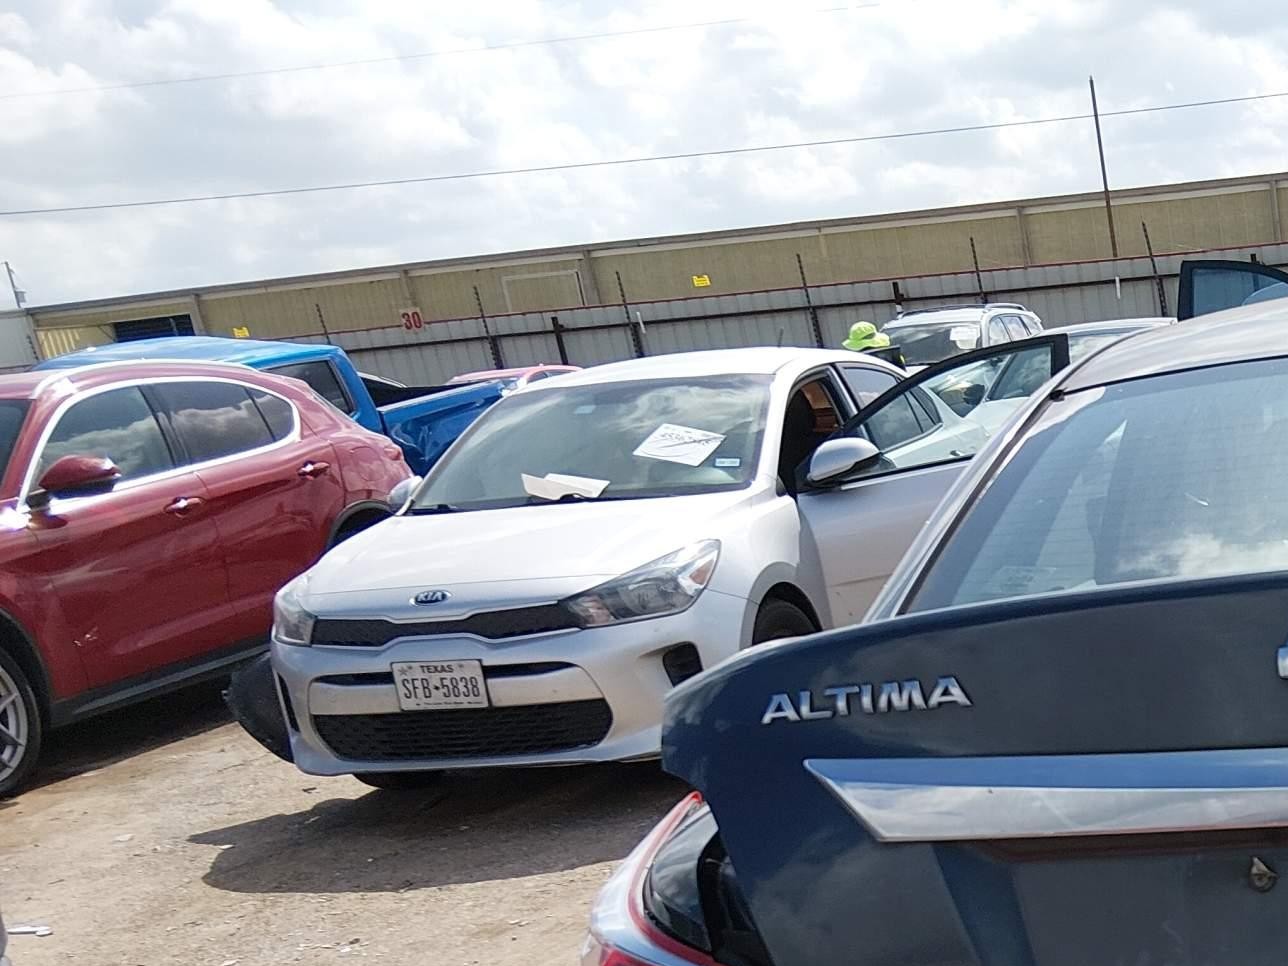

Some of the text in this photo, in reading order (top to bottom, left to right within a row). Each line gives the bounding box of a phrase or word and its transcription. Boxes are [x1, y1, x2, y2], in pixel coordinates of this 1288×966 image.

[401, 311, 423, 330] 30
[417, 591, 442, 602] KIA
[419, 664, 454, 674] TEXAS
[760, 674, 974, 726] ALTIMA
